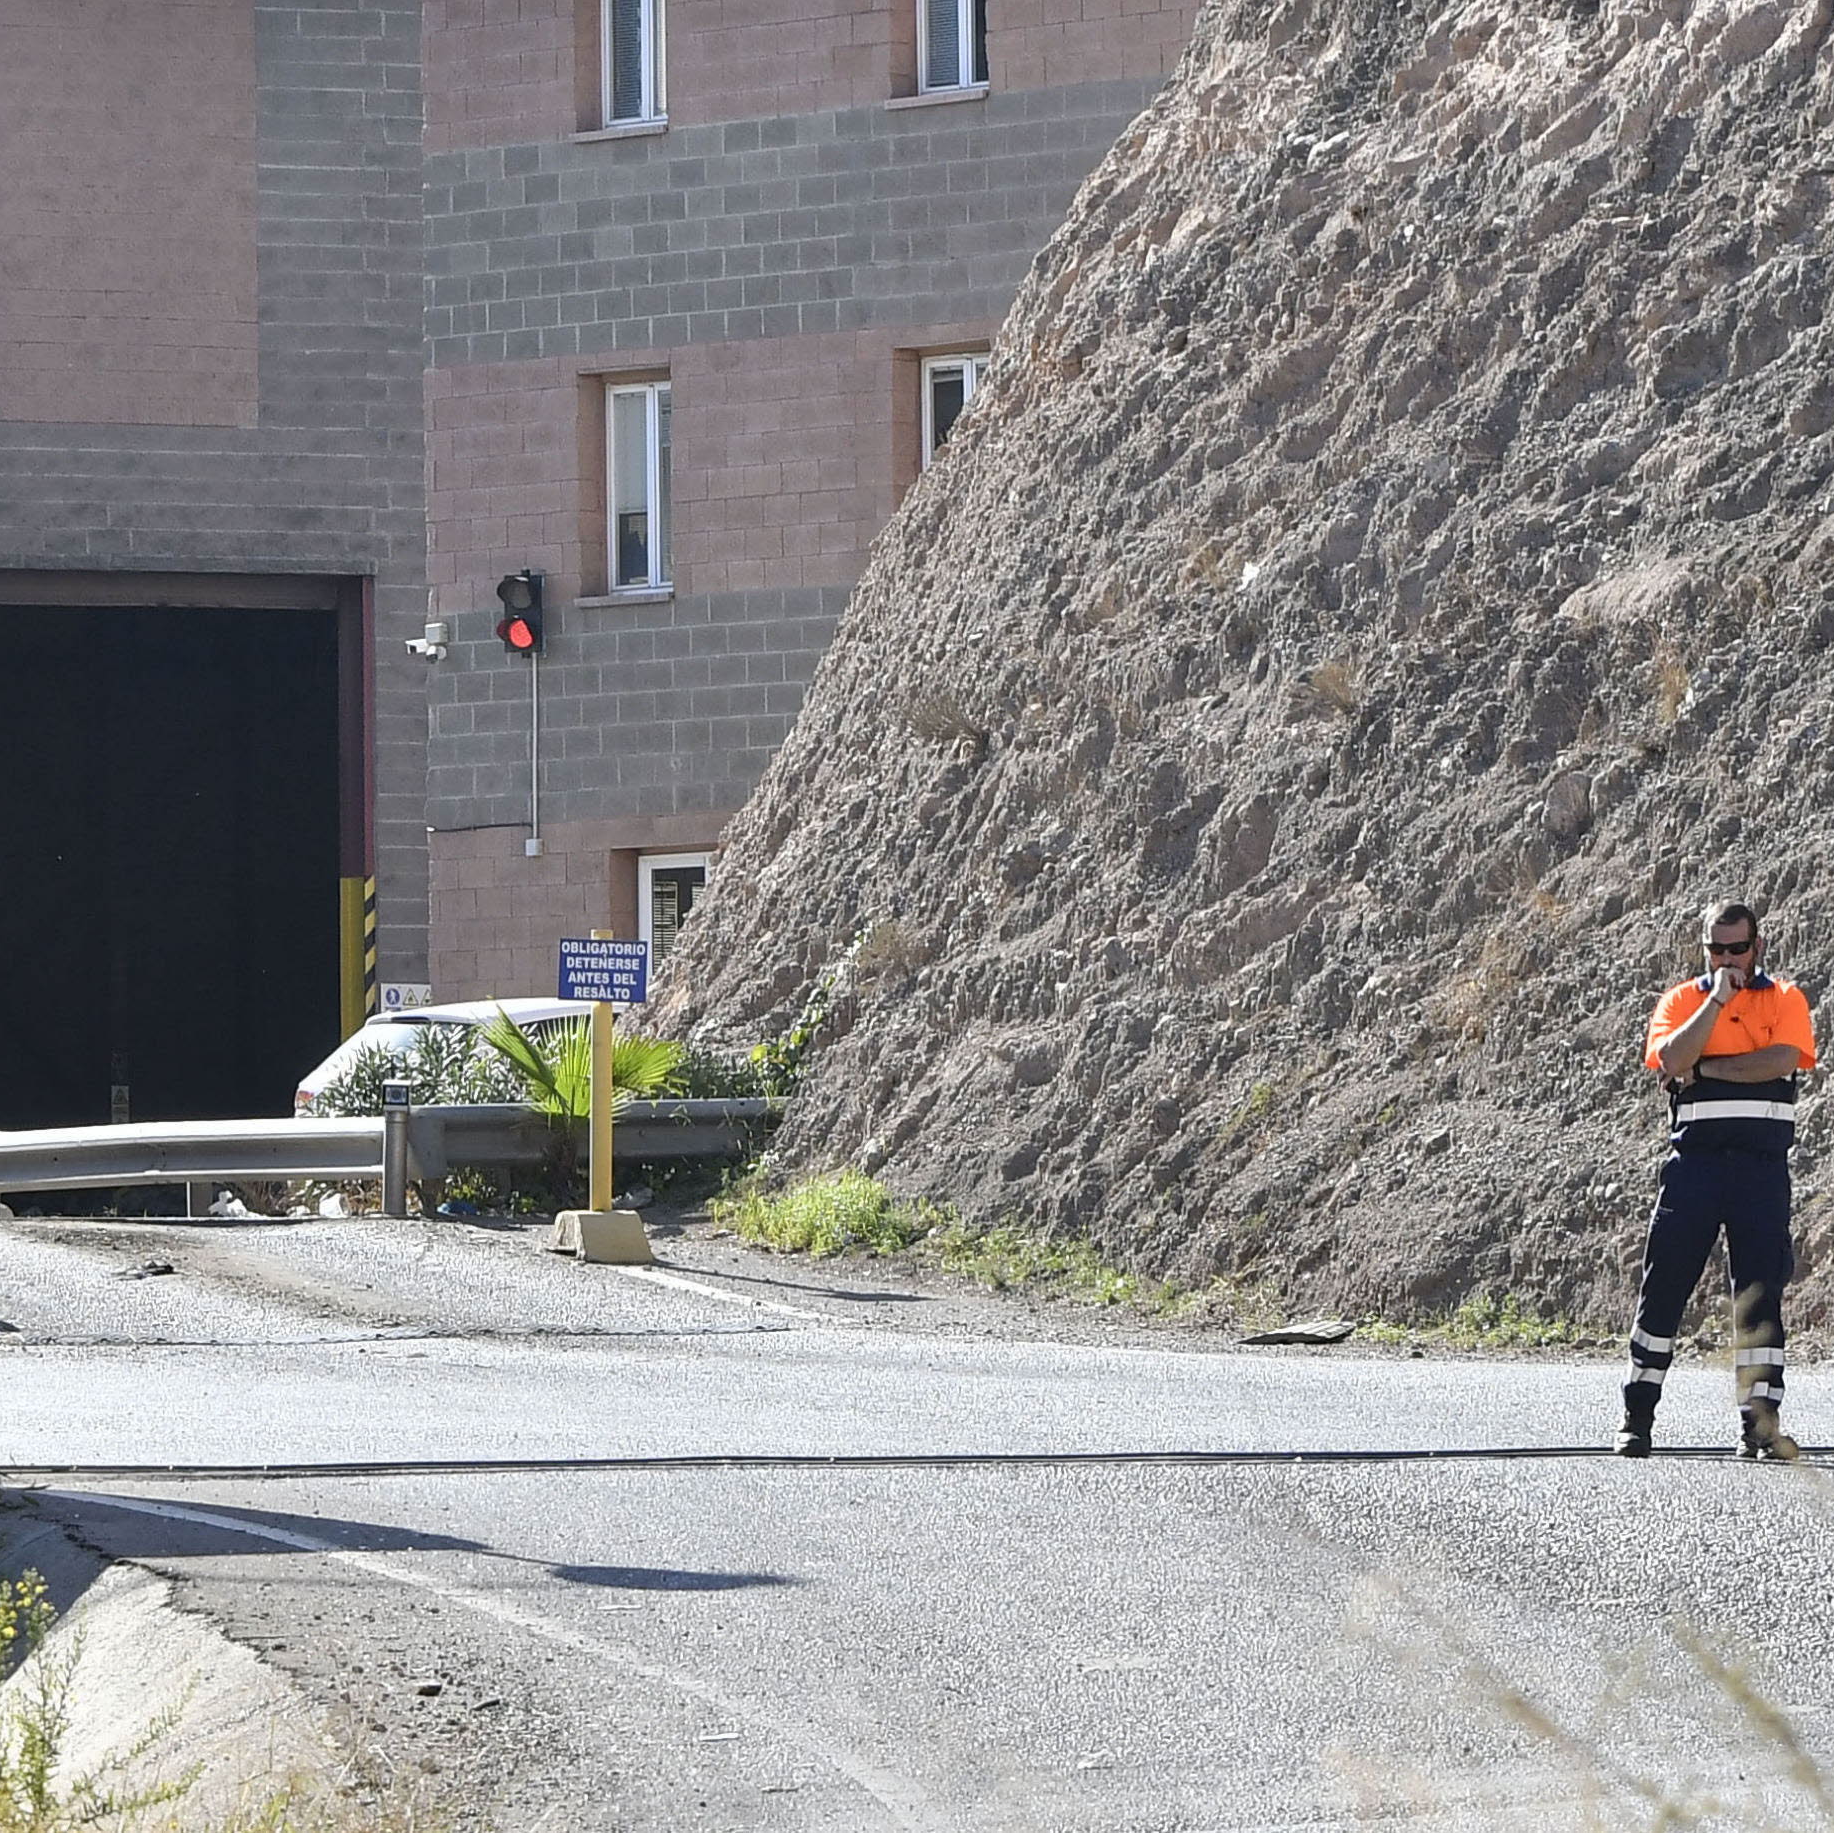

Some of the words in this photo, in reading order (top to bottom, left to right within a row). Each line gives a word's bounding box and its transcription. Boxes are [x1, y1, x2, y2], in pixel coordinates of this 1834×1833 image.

[561, 941, 646, 955] OBLIGATORIO
[567, 956, 640, 970] DETENERSE
[568, 971, 609, 985] ANTES
[613, 974, 637, 985] DEL
[574, 985, 630, 1000] RESALTO
